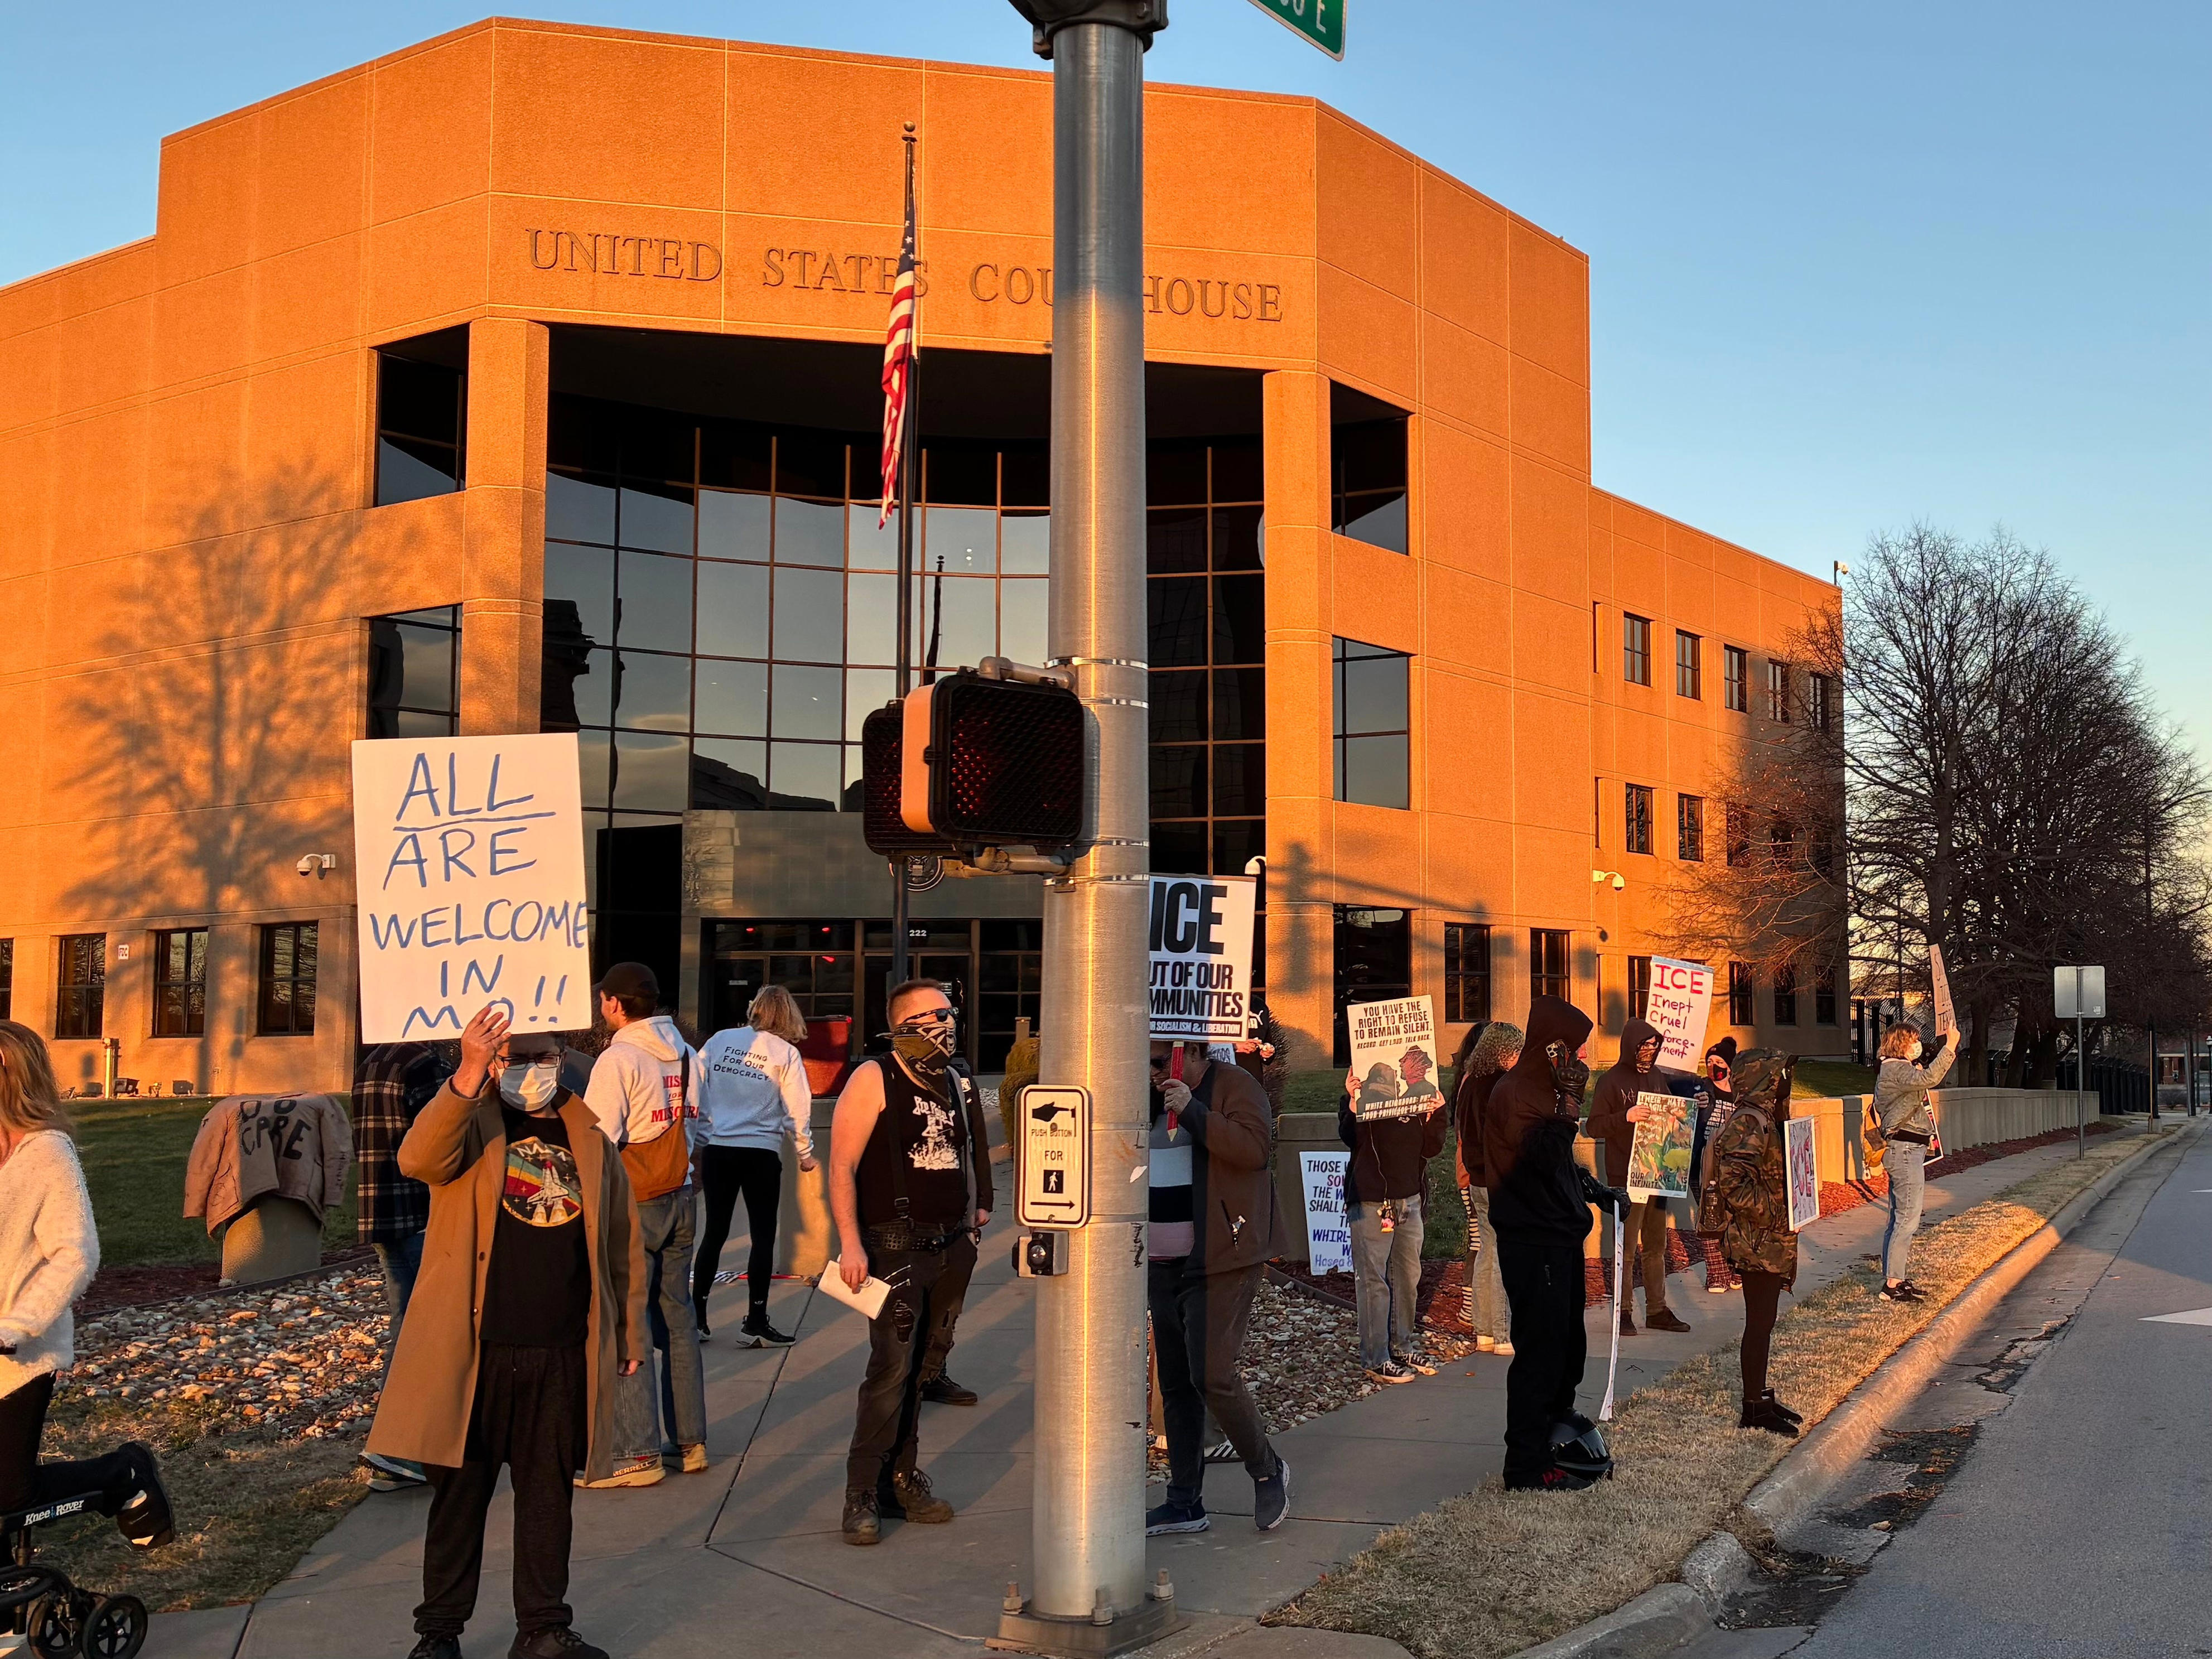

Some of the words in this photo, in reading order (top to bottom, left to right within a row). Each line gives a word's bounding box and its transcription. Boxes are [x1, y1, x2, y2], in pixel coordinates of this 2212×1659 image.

[526, 228, 722, 281] UNITED
[763, 247, 928, 297] STATES
[969, 263, 1283, 322] COUHOUSE
[396, 752, 534, 821] ALL
[383, 826, 537, 891] ARE
[369, 899, 587, 950] WELCOME
[1149, 881, 1227, 955] ICE
[440, 954, 503, 997] IN
[1149, 961, 1170, 987] UT
[1172, 961, 1194, 987] OF
[1196, 962, 1233, 990] OUR
[1654, 964, 1704, 995] ICE
[1149, 988, 1243, 1017] MMUNITIES
[1363, 1006, 1380, 1017] YOU
[1382, 1004, 1404, 1015] HAVE
[1406, 1001, 1421, 1012] THE
[1651, 994, 1694, 1016] Inept
[1156, 1021, 1192, 1032] SOCIALISM
[1192, 1023, 1201, 1033] &
[1202, 1023, 1241, 1034] LIBERATION
[1358, 1016, 1382, 1028] RIGHT
[1385, 1015, 1395, 1025] TO
[1398, 1011, 1428, 1024] REFUSE
[1650, 1010, 1687, 1029] Cruel
[1354, 1029, 1365, 1040] TO
[1368, 1025, 1400, 1038] REMAIN
[1404, 1021, 1432, 1034] SILENT.
[1662, 1029, 1695, 1048] force-
[723, 1055, 742, 1065] FOR
[745, 1060, 764, 1069] OUR
[725, 1046, 768, 1062] FIGHTING
[714, 1064, 769, 1081] DEMOCRACY
[1640, 1094, 1661, 1104] THEIR
[1668, 1098, 1686, 1107] HATE
[1044, 1150, 1063, 1161] FOR
[1307, 1160, 1341, 1173] THOSE
[1655, 1173, 1672, 1182] LOVE
[1313, 1186, 1333, 1198] THE
[1309, 1200, 1339, 1212] SHALL
[1313, 1229, 1351, 1242] WHIRL-
[1315, 1254, 1345, 1267] Hosea
[613, 1462, 651, 1477] MERRELL
[23, 1509, 51, 1526] Knee
[56, 1499, 84, 1516] Rover
